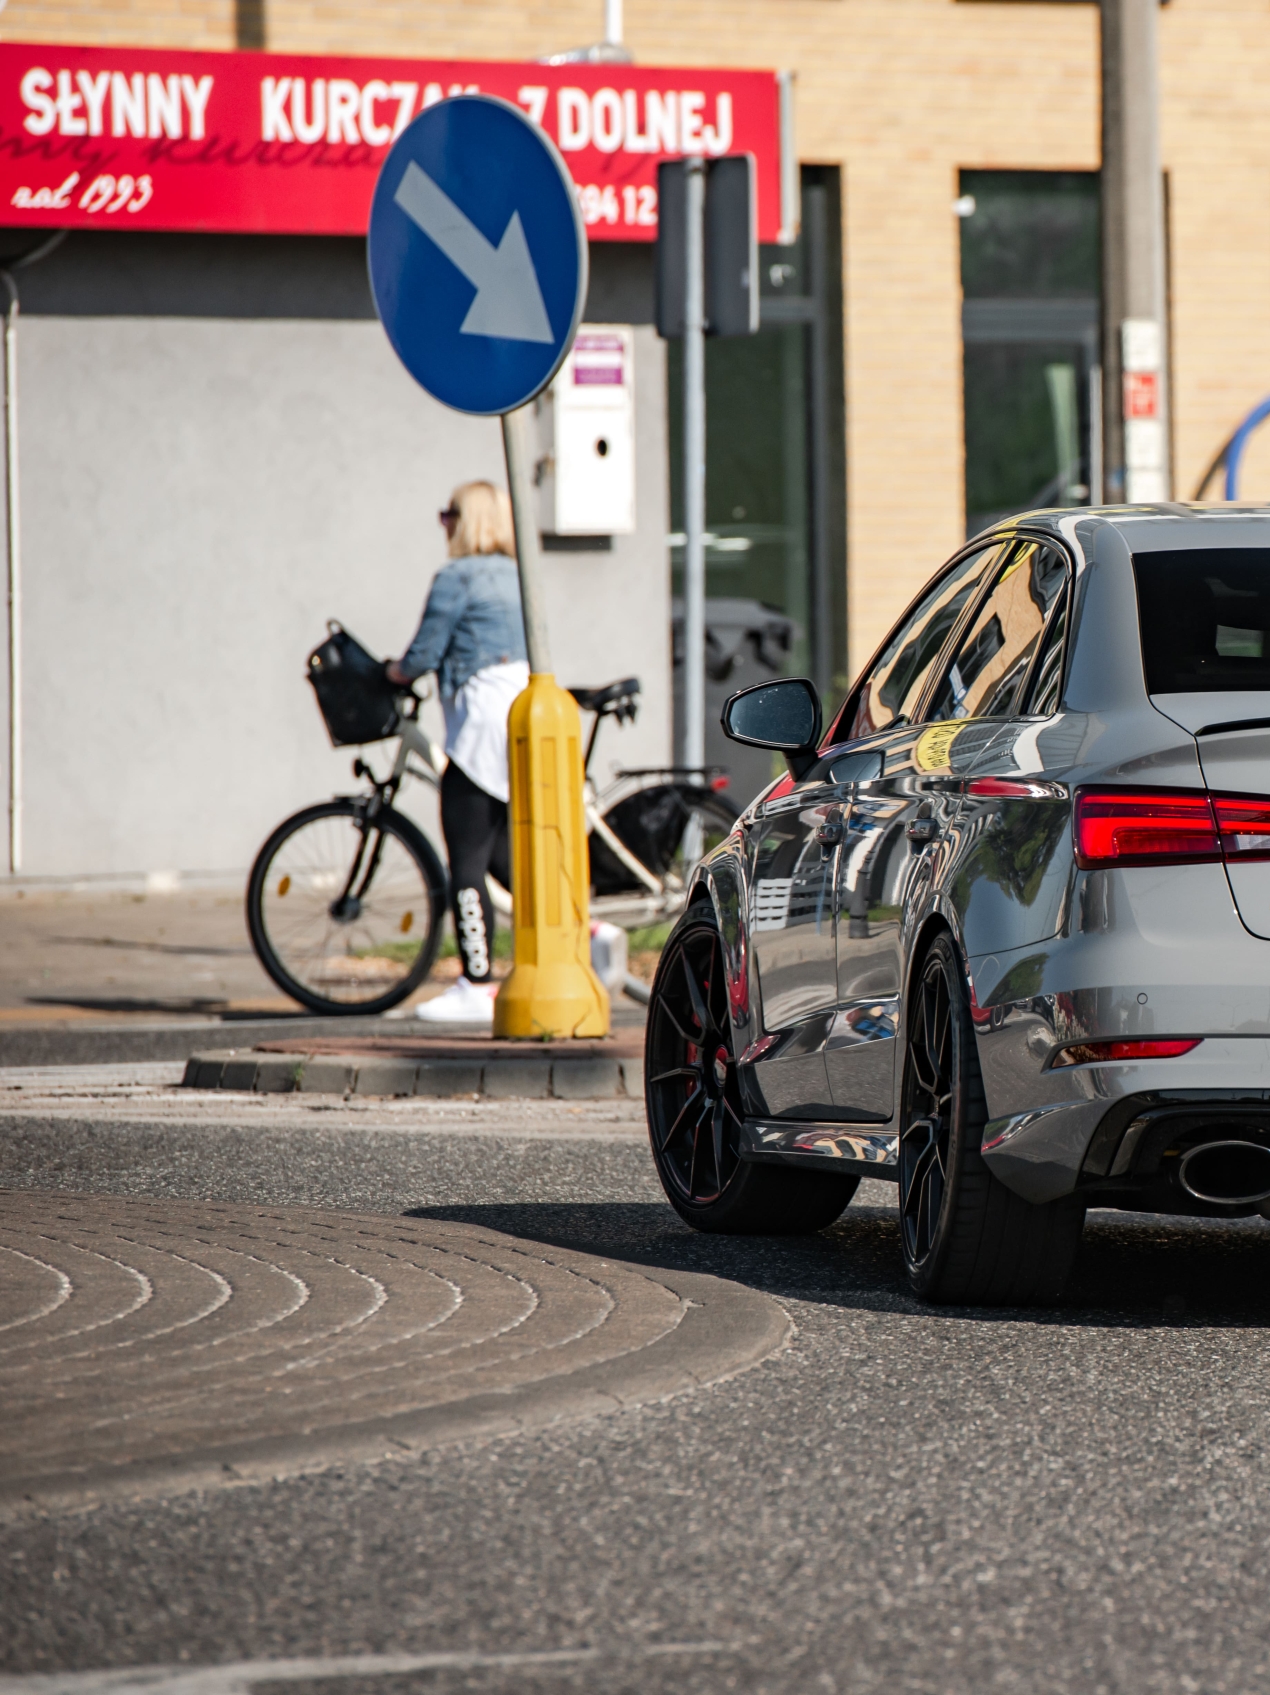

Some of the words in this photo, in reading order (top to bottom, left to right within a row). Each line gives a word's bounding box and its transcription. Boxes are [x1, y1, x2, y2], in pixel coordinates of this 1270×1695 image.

[20, 67, 214, 140] SŁYNNY
[260, 76, 481, 146] KURCZ
[557, 87, 733, 156] DOLNEJ
[77, 174, 153, 213] 1993
